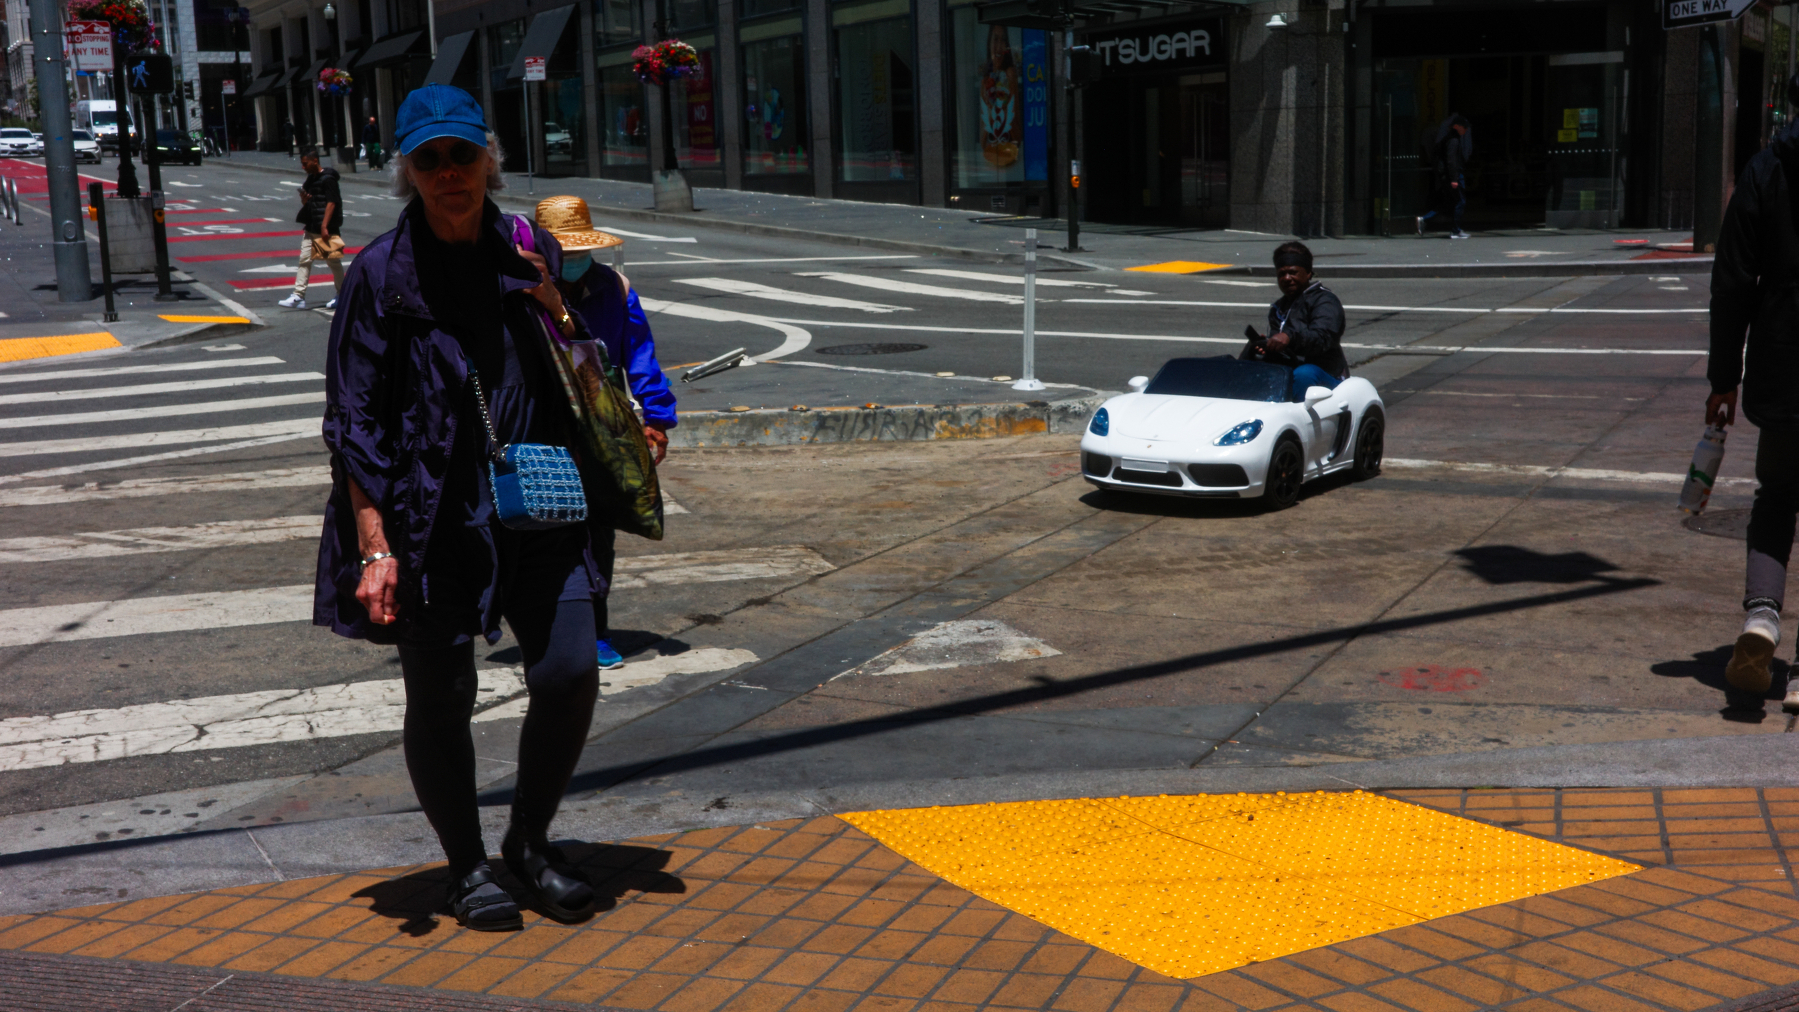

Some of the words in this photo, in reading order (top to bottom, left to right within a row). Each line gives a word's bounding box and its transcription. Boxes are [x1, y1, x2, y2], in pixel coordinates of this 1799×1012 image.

[1673, 2, 1698, 17] ONE
[1702, 0, 1727, 12] WAY
[68, 34, 82, 43] NO
[71, 47, 88, 56] ANY
[90, 47, 109, 56] TIME
[694, 104, 707, 122] NO
